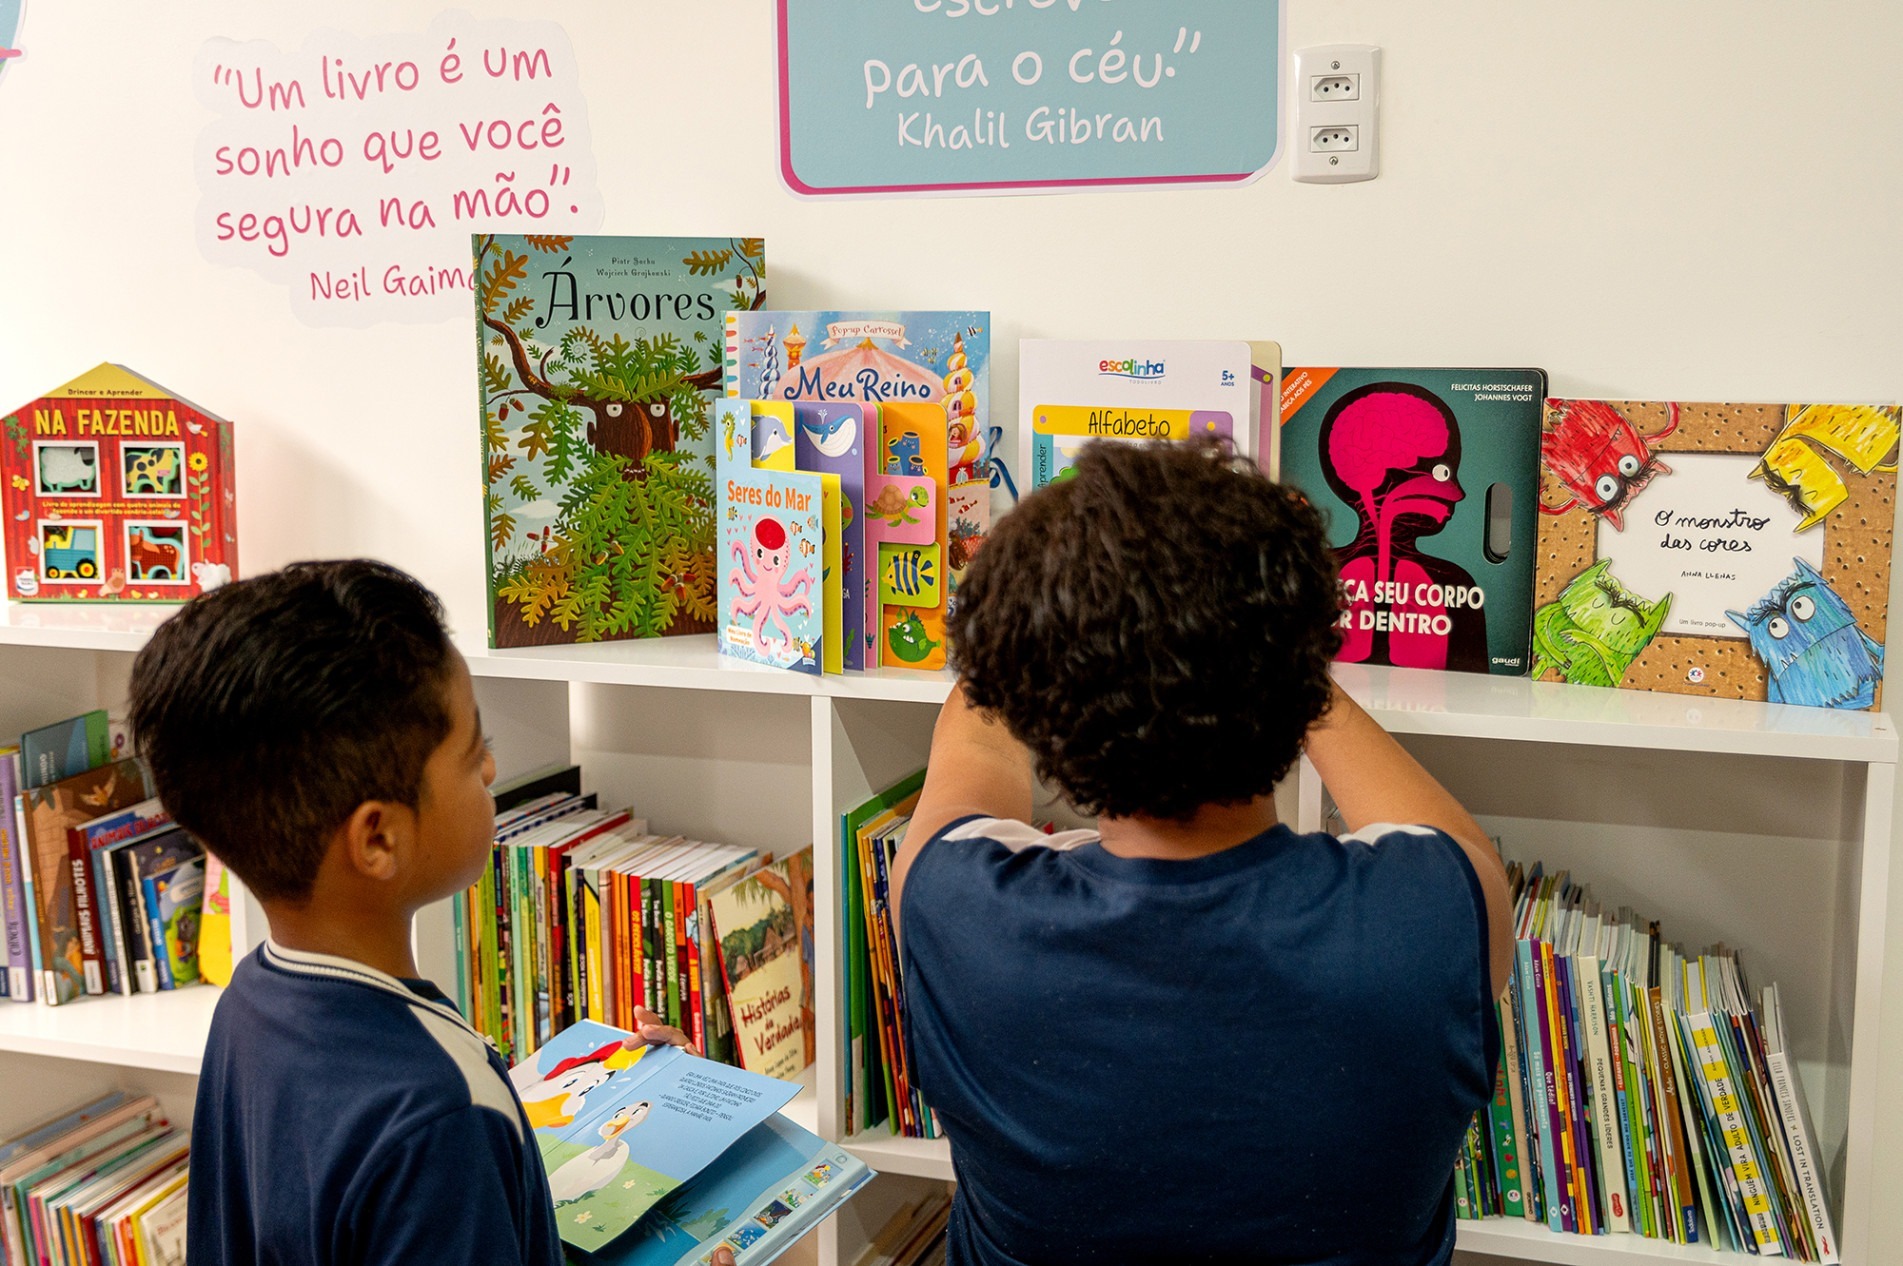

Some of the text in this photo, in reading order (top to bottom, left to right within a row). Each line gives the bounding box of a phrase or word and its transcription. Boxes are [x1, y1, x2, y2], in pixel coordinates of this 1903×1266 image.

[321, 55, 419, 100] livro
[439, 37, 463, 84] é
[483, 47, 552, 80] um
[864, 53, 988, 108] para
[1011, 50, 1044, 86] o
[214, 102, 566, 178] sonho que você
[897, 108, 1164, 149] Khalil Gibran
[215, 201, 362, 257] segura
[379, 196, 435, 231] na
[309, 267, 370, 301] Neil
[535, 256, 715, 329] Árvores
[863, 324, 902, 338] Carrossel
[1099, 358, 1164, 376] escolinha
[1221, 370, 1235, 381] 5+
[68, 388, 97, 396] Brincar
[106, 388, 143, 396] Aprender
[784, 366, 931, 401] Meu Reino
[1283, 371, 1308, 397] INTERATIVO
[1451, 383, 1481, 391] FELICITAS
[1474, 393, 1533, 402] JOHANNES VOGT
[35, 409, 180, 436] NA FAZENDA
[1088, 410, 1171, 437] Alfabeto
[1037, 443, 1049, 488] Aprender
[727, 480, 812, 512] Seres do Mar
[1655, 508, 1771, 530] O monstro
[1660, 533, 1752, 552] das cores
[1705, 572, 1736, 580] LLENAS
[1374, 580, 1409, 604] SEU
[1415, 584, 1485, 610] CORPO
[1359, 610, 1452, 635] DENTRO
[1690, 618, 1703, 626] livro
[72, 859, 96, 955] ANIMAIS FILHOTES
[664, 911, 677, 984] O GAROTO VERDE
[741, 985, 791, 1029] Histórias
[1587, 980, 1598, 1036] VASHTI HARRISON
[753, 1014, 801, 1056] Verdade
[765, 1018, 774, 1032] da
[1656, 1024, 1664, 1043] MOVIE
[1534, 1063, 1542, 1078] mais
[1659, 1043, 1670, 1070] CLASSIC
[1536, 1079, 1543, 1089] um
[1544, 1071, 1556, 1105] Que tédio!
[1537, 1090, 1548, 1129] pensamento
[1597, 1058, 1613, 1149] PEQUENAS GRANDES LÍDERES
[1714, 1077, 1761, 1206] NINGUÉM VIRA ADULTO DE VERDADE
[1792, 1135, 1825, 1230] LOST IN TRANSLATION
